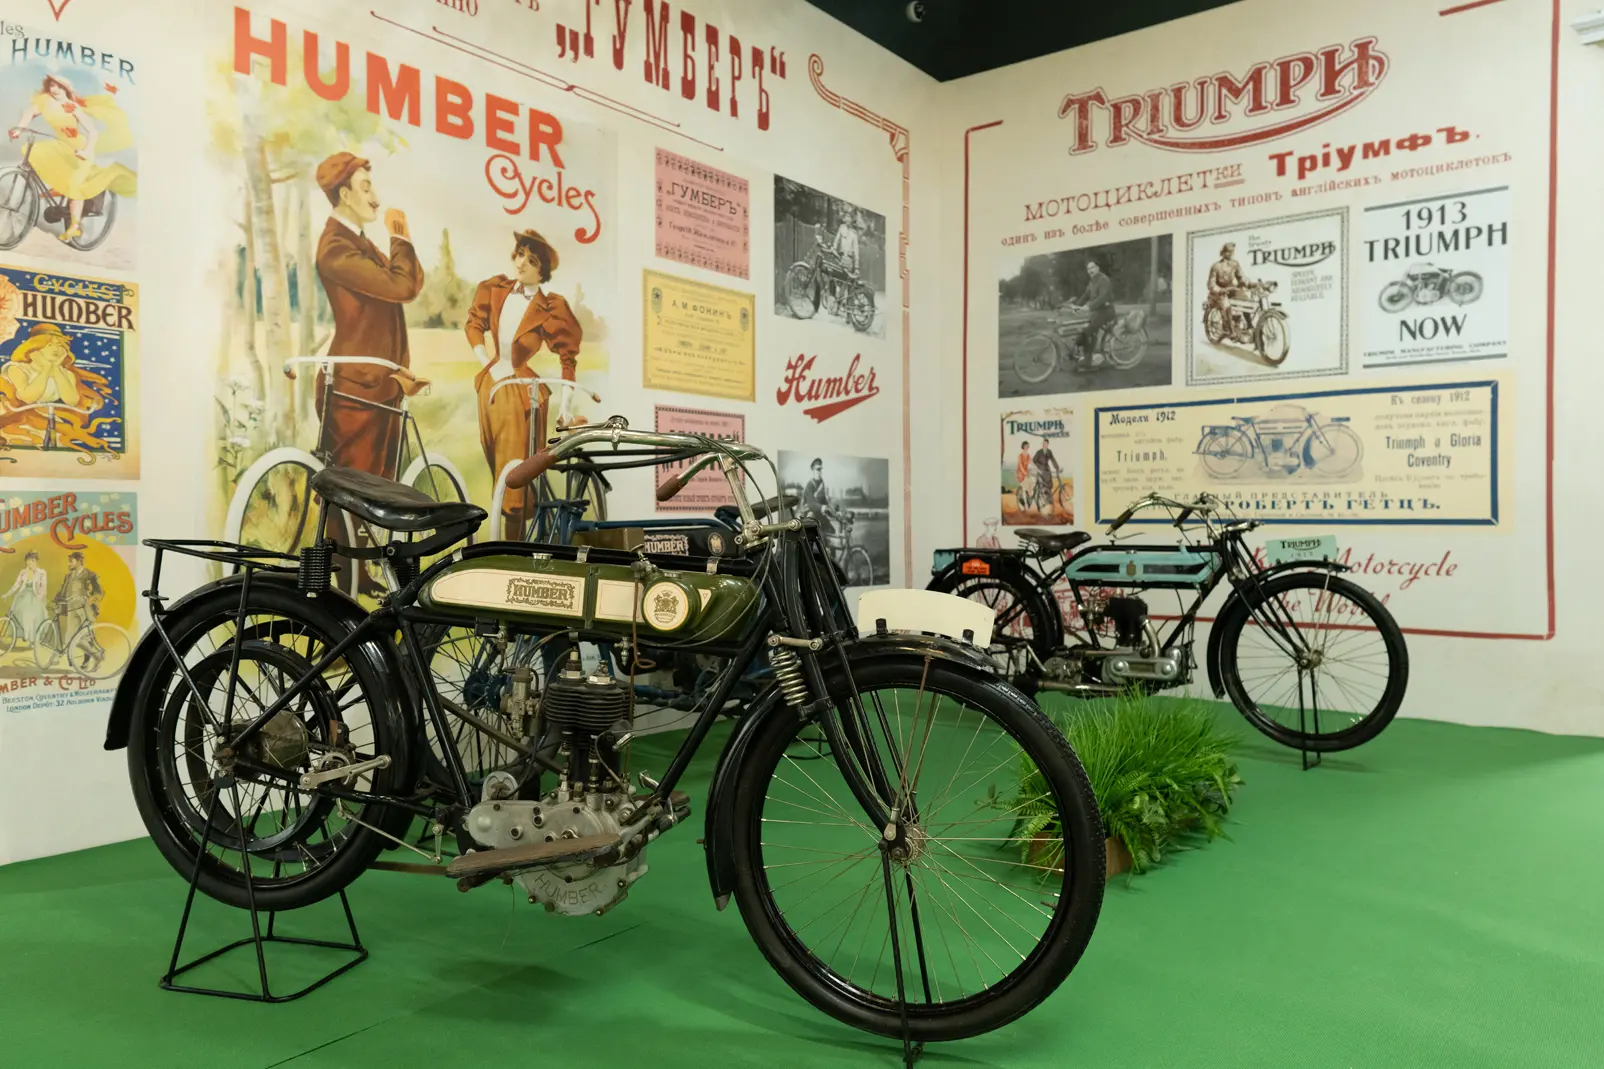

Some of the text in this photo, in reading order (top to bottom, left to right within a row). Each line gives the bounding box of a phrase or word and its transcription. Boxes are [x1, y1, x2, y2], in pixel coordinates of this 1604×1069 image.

[12, 37, 136, 85] HUMBER
[233, 6, 565, 168] HUMBER
[1059, 36, 1390, 155] TRIUMPH
[485, 153, 601, 244] Cycles
[1001, 232, 1037, 247] одинъ
[1044, 228, 1065, 239] изъ
[1119, 201, 1221, 227] совершенныхъ
[1230, 191, 1283, 208] типовъ
[1391, 152, 1512, 182] мотоциклетокъ
[1402, 201, 1468, 230] 1913
[1247, 240, 1336, 267] TRIUMPH
[1364, 222, 1508, 262] TRIUMPH
[22, 292, 136, 331] HUMBER
[1400, 314, 1468, 342] NOW
[776, 353, 880, 406] Humber
[1006, 420, 1065, 437] TRIUMPH
[1109, 411, 1176, 426] Модели 1912
[1385, 435, 1426, 451] Triumph
[1450, 433, 1482, 448] Gloria
[1407, 453, 1452, 468] Coventry
[1174, 491, 1242, 500] ГЛАНЫЙ
[0, 492, 77, 534] UMBER
[50, 510, 134, 550] CYCLES
[644, 540, 685, 553] HUMBER
[1280, 540, 1321, 551] TRIUMPH
[513, 584, 569, 601] HUMBER
[43, 676, 54, 686] &
[535, 873, 603, 905] HUMBER
